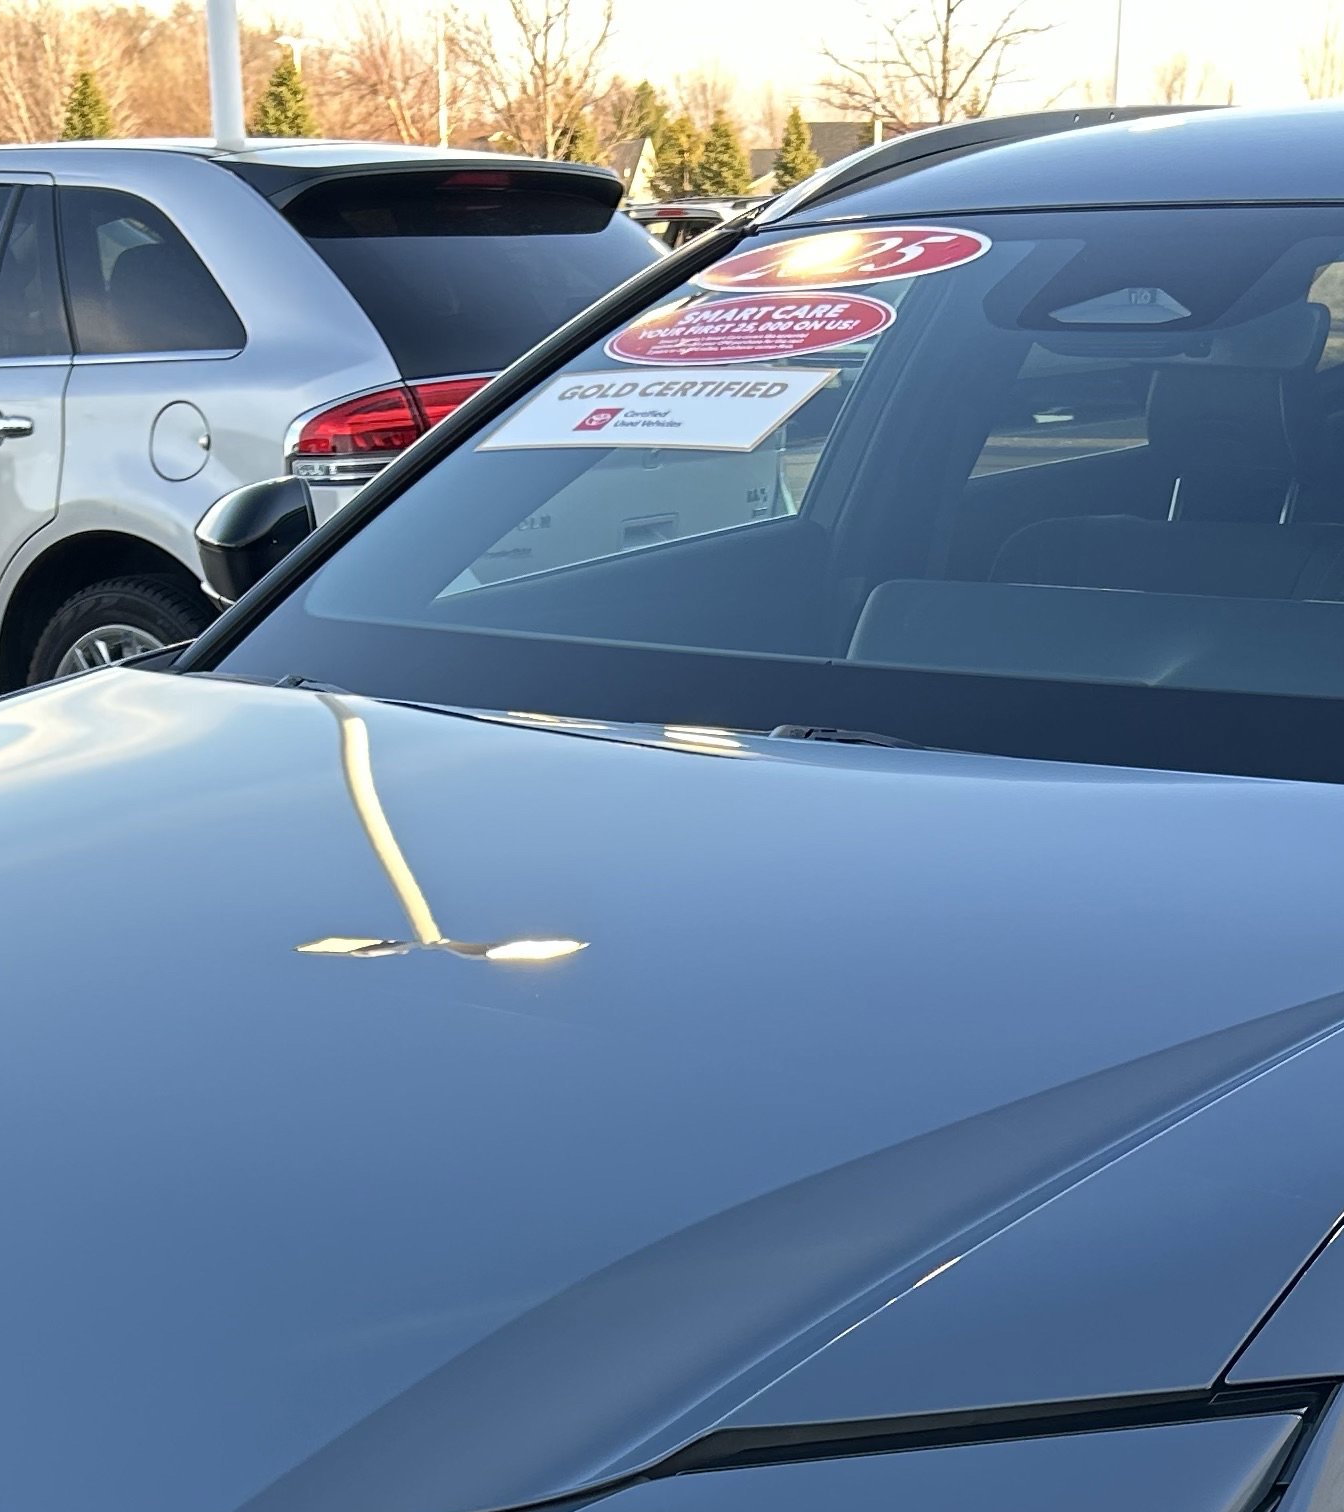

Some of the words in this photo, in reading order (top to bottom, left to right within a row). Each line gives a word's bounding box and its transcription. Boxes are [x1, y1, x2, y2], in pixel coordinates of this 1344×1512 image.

[677, 305, 773, 326] SMART
[770, 302, 851, 321] CARE
[638, 323, 686, 340] YOUR
[683, 321, 732, 336] FIRST
[730, 319, 796, 335] 25,000
[794, 319, 826, 331] ON
[823, 318, 861, 331] US!
[557, 382, 640, 401] GOLD
[638, 380, 789, 399] CERTIFIED
[613, 419, 642, 428] Used
[640, 420, 682, 428] Vehicles
[623, 410, 671, 418] Certified
